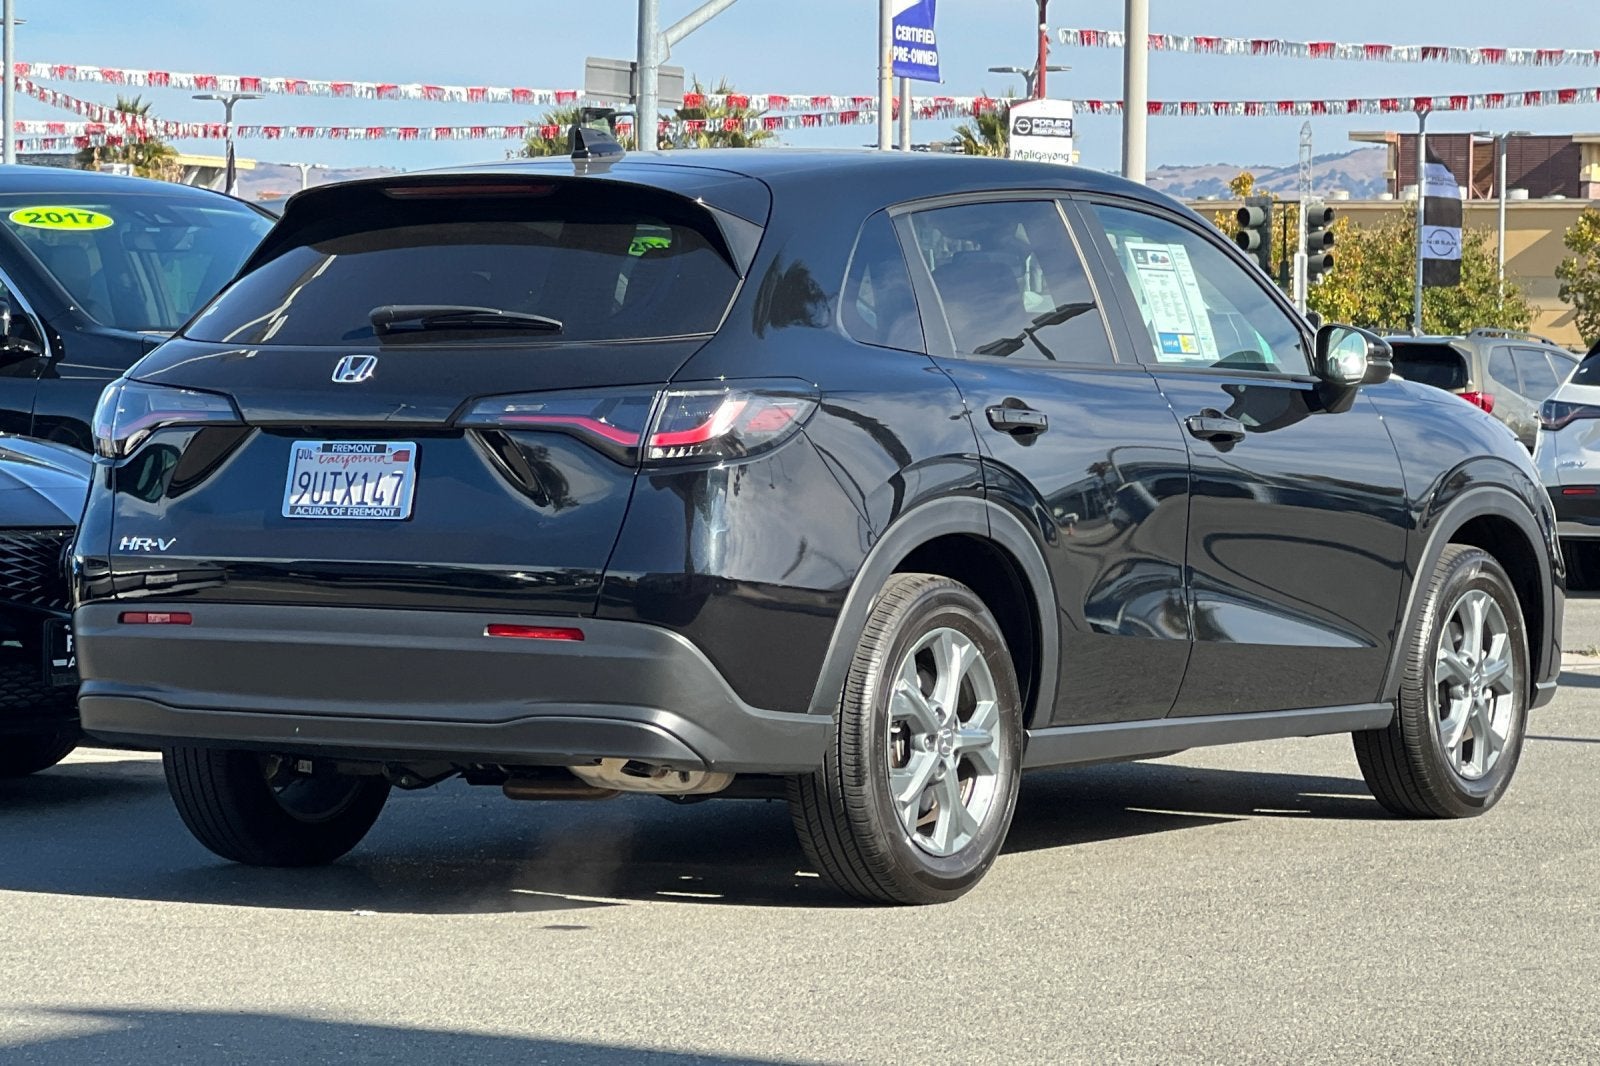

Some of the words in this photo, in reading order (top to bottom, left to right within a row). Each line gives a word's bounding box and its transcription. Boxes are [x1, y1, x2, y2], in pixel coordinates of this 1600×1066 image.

[895, 24, 936, 45] CERTIFIED
[892, 45, 938, 66] PRE-OWNED
[24, 211, 95, 224] 2017
[298, 449, 314, 460] JUL
[331, 444, 377, 454] FREMONT
[318, 454, 393, 469] California
[294, 471, 404, 506] 9UIX147
[294, 506, 329, 516] ACURA
[331, 507, 346, 516] OF
[347, 508, 397, 517] FREMONT
[119, 536, 177, 551] HR-V
